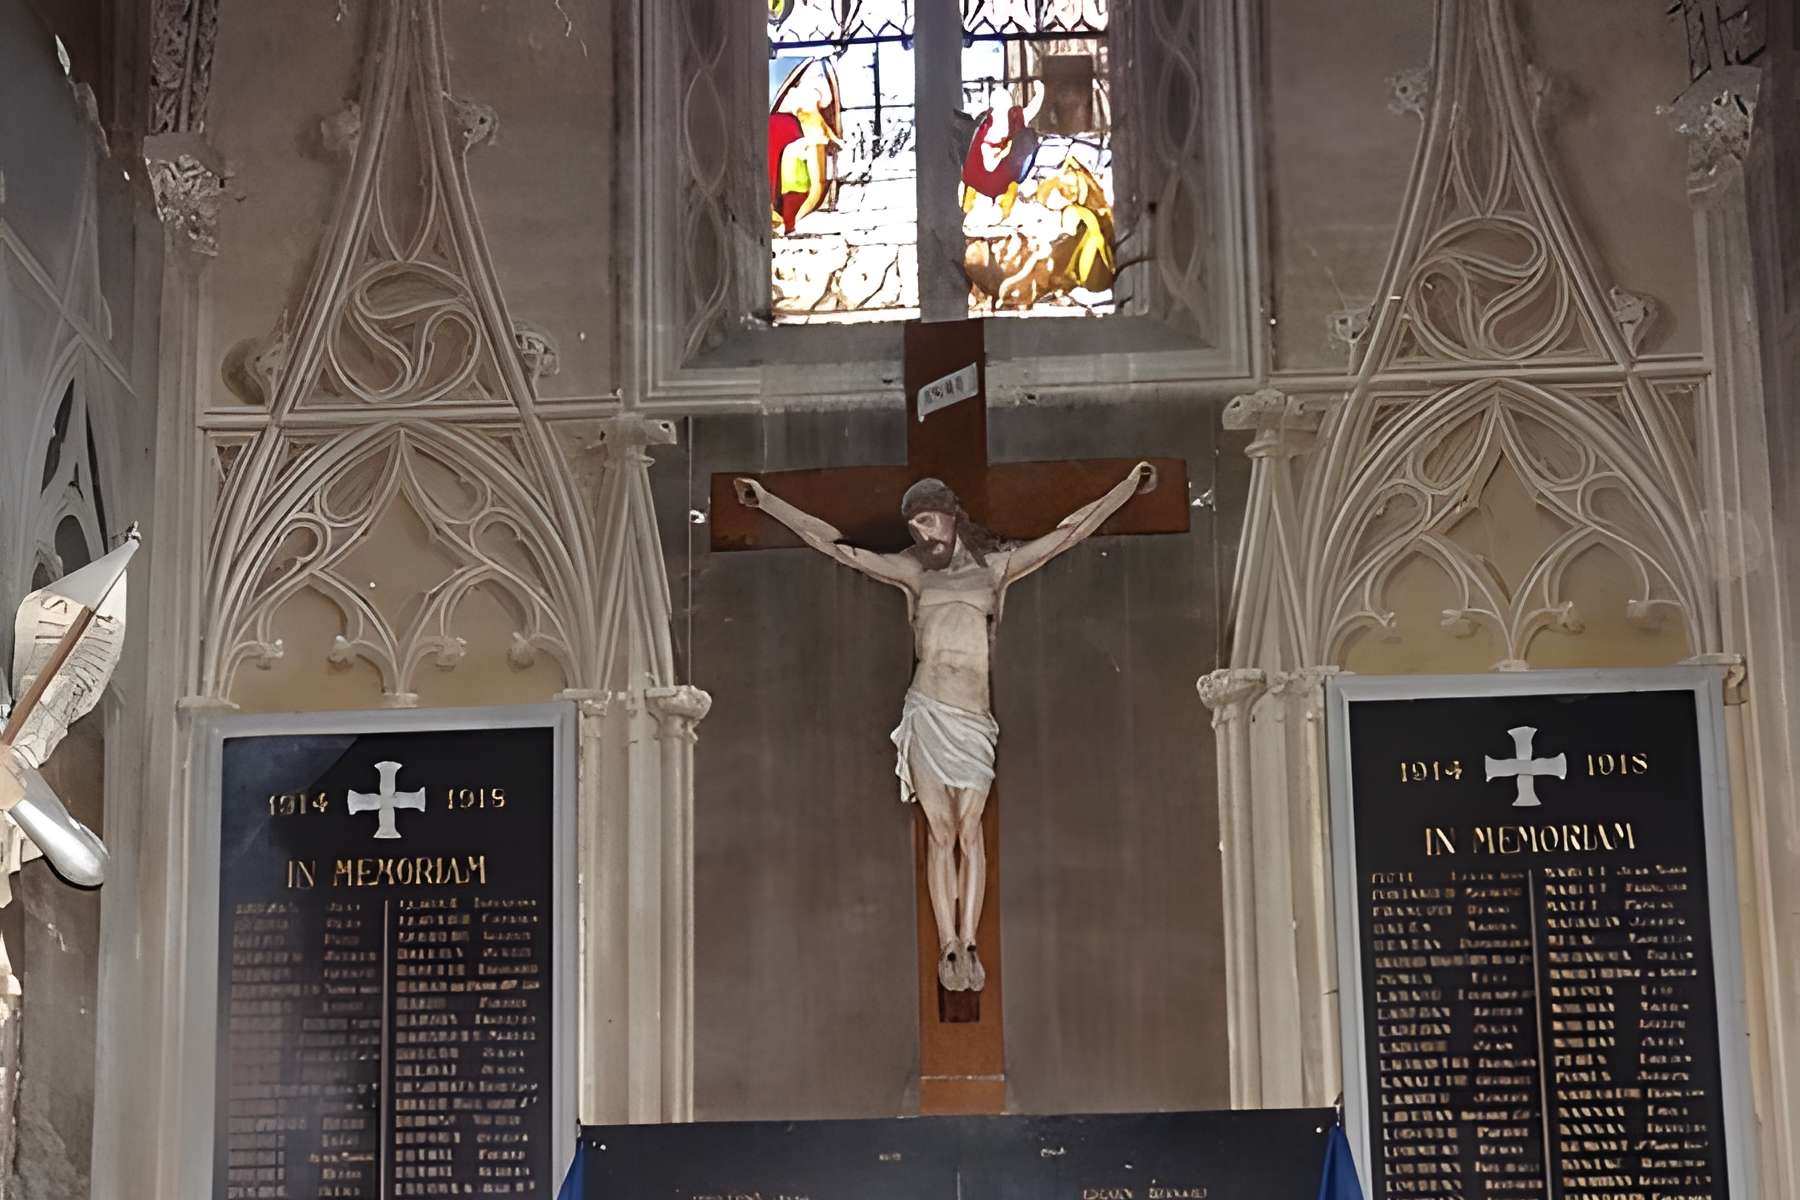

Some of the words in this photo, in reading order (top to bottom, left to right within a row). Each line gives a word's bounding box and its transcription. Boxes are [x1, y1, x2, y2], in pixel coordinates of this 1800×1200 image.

[1399, 760, 1464, 783] 1914
[1586, 752, 1649, 777] 1918
[268, 792, 329, 817] 1914
[1424, 826, 1456, 856] IN
[1473, 821, 1637, 855] MEMORIAM
[286, 859, 316, 889] IN
[333, 855, 488, 888] MEMORIAM
